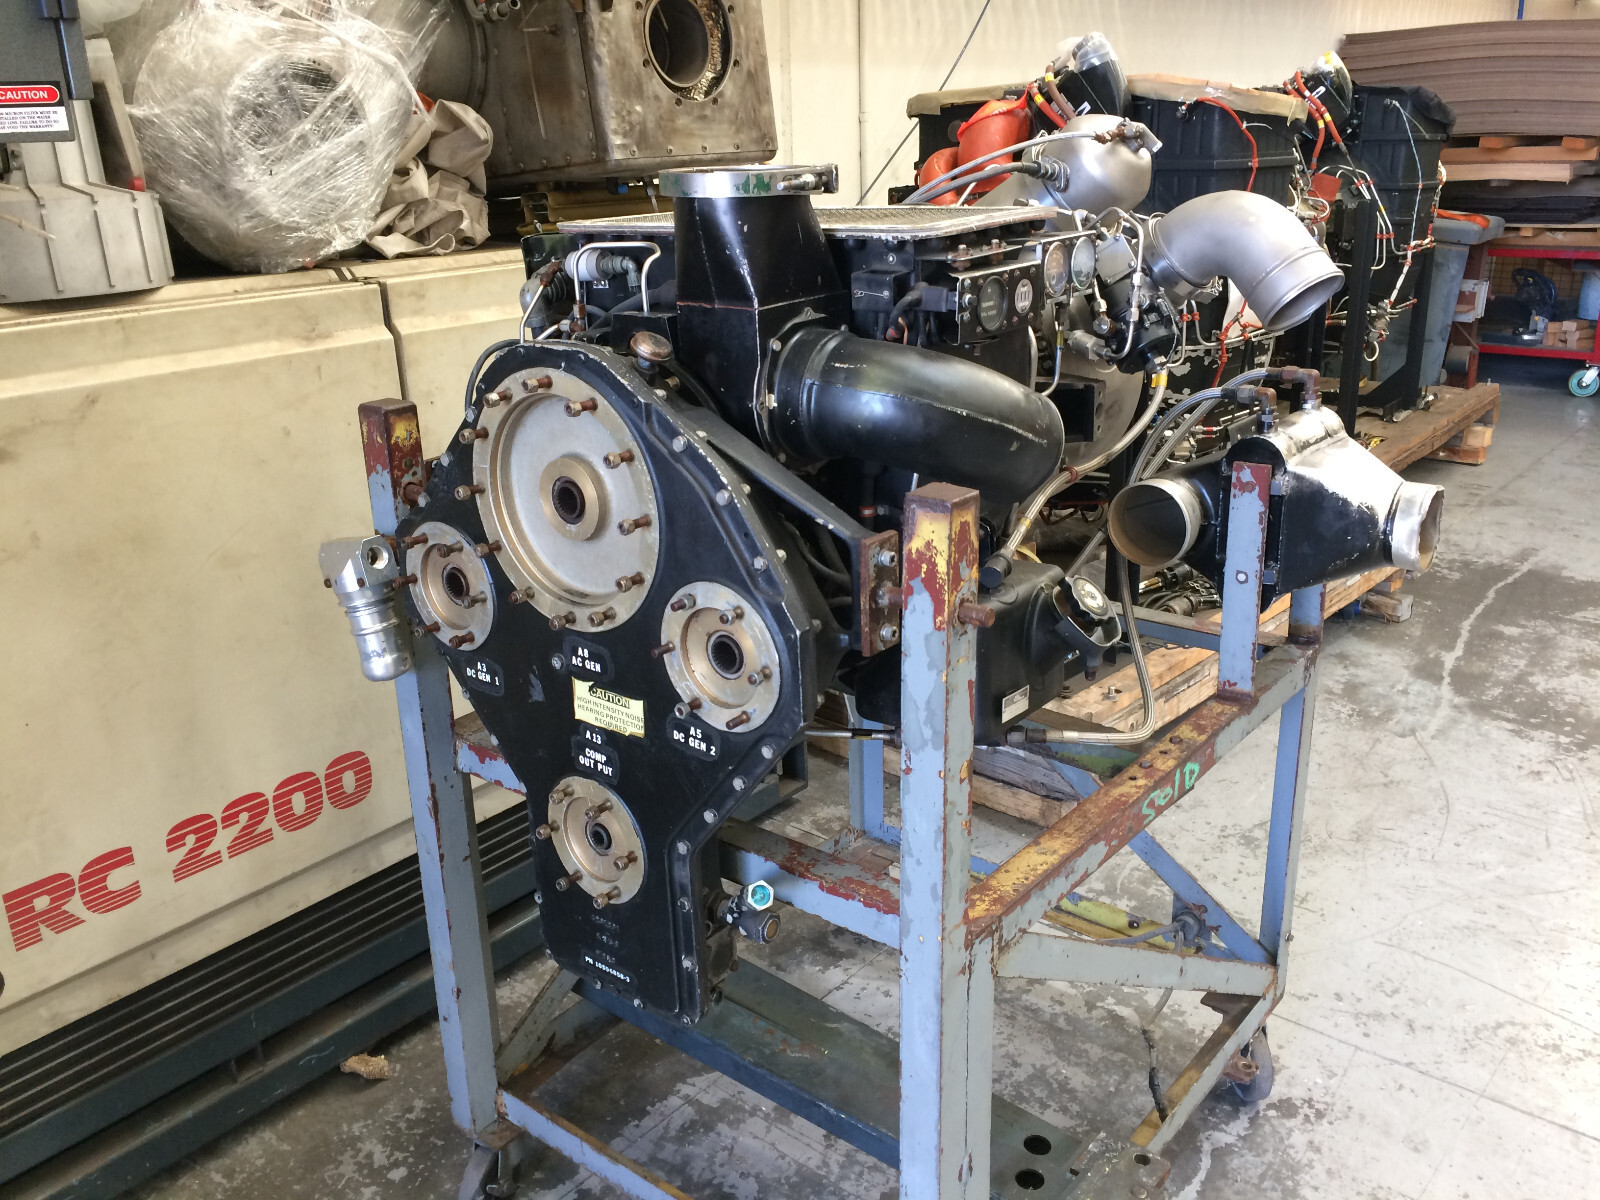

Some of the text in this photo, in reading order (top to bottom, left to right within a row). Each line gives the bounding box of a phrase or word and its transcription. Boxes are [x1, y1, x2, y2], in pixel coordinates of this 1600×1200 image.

[0, 90, 48, 100] CAUTION
[571, 656, 602, 673] AC GEN
[466, 667, 500, 686] DC GEN 1
[590, 687, 630, 709] CAUTION
[576, 696, 645, 724] HIGH INTENSITY NOISE
[577, 704, 644, 731] HEARING PROTECTION
[594, 716, 628, 733] REQUIRED
[673, 730, 716, 756] DC GEN 2
[579, 755, 613, 777] OUT PUT
[585, 748, 607, 764] COMP
[2, 750, 373, 952] RC 2200
